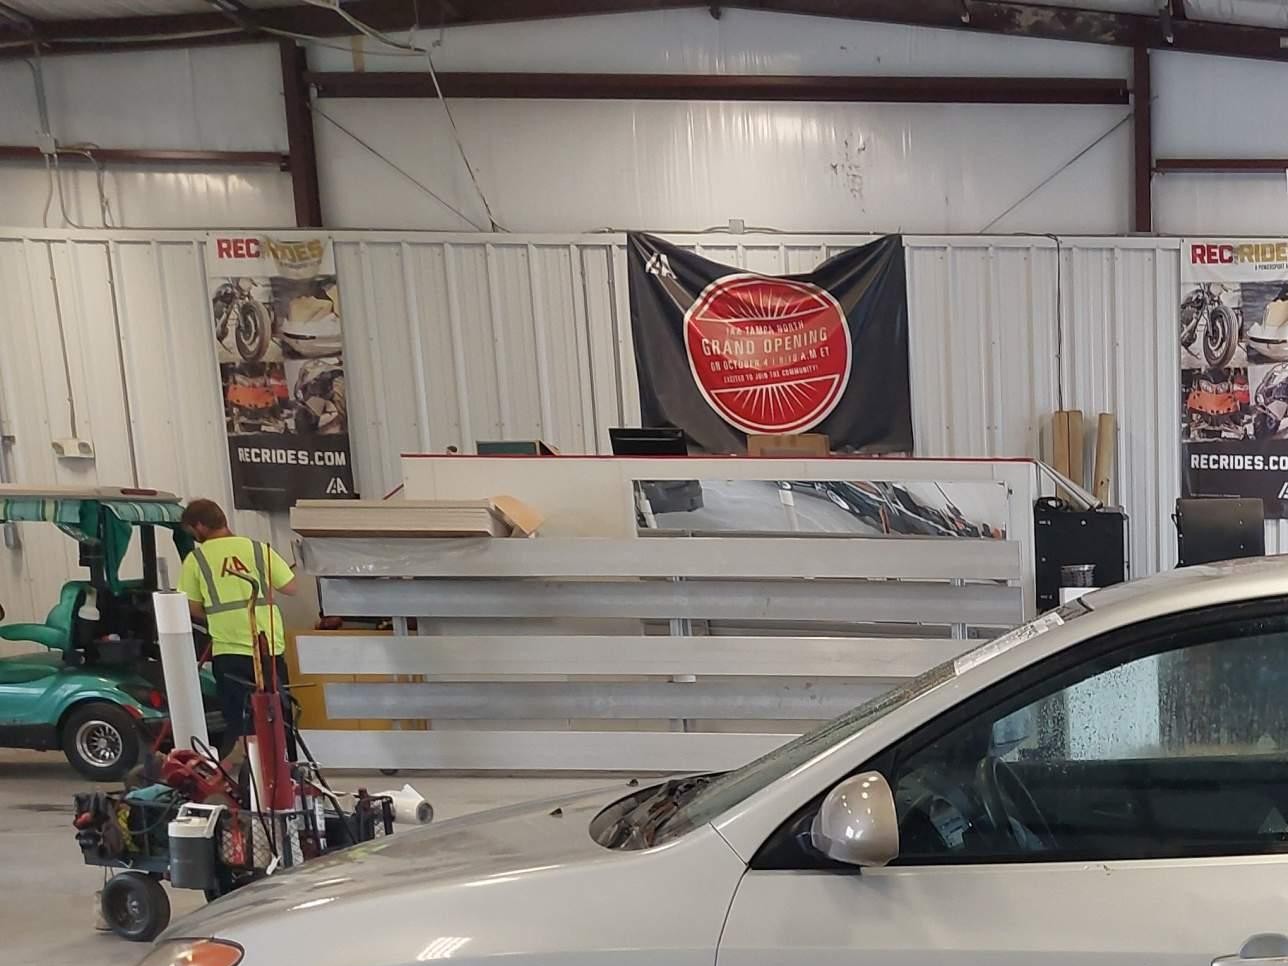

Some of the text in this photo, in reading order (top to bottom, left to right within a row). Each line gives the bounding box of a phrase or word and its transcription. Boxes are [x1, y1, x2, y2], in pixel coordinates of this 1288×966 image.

[216, 238, 261, 259] REC
[1191, 244, 1234, 264] REC
[777, 321, 805, 334] NORTH
[701, 327, 828, 356] GRAND OPENING
[710, 361, 721, 372] ON
[723, 358, 760, 370] OCTOBER
[820, 346, 830, 357] ET
[237, 447, 347, 466] RECRIDES.COM
